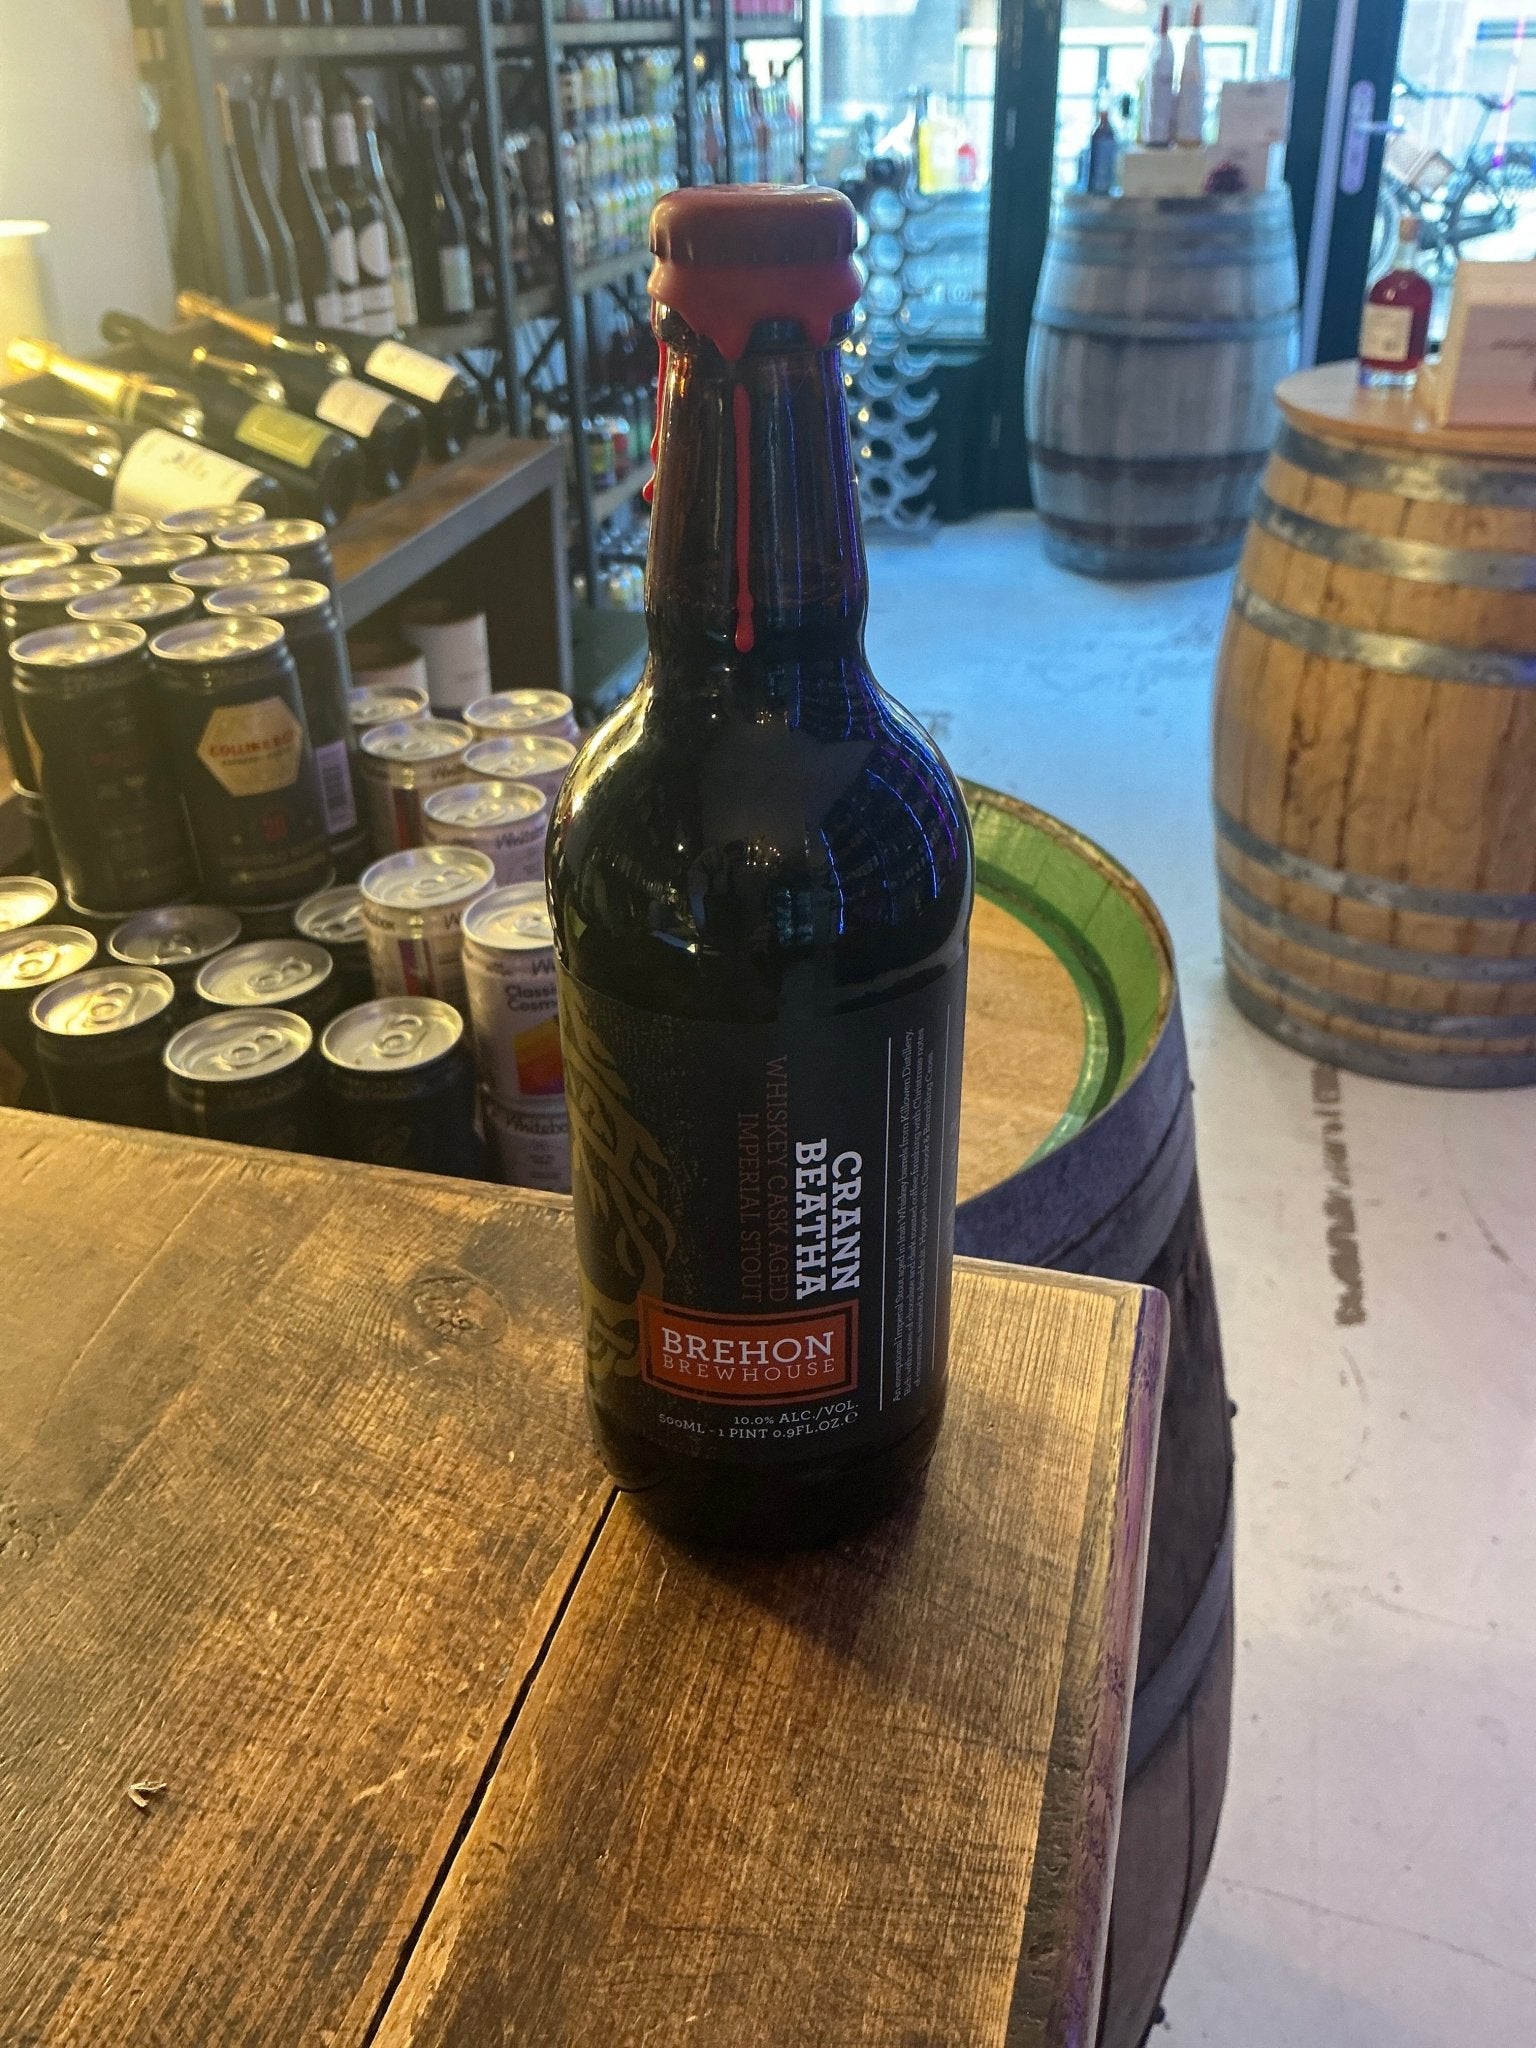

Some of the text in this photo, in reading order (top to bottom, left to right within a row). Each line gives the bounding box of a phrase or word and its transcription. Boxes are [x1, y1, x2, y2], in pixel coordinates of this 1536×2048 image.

[899, 1077, 910, 1122] Killowen
[898, 1122, 909, 1146] from
[765, 1054, 789, 1302] WHISKEY CASK AGED
[738, 1112, 762, 1303] IMPERIAL STOUT
[795, 1138, 827, 1300] BEATHA
[831, 1151, 863, 1291] CRANN
[897, 1181, 909, 1222] Whiskey
[897, 1222, 906, 1243] Irish
[896, 1254, 906, 1277] aged
[661, 1326, 834, 1366] BREHON
[662, 1354, 835, 1382] BREWHOUSE
[659, 1413, 705, 1434] 500ML
[729, 1428, 768, 1439] PINT
[734, 1399, 860, 1425] 10.0% ALC./VOL.
